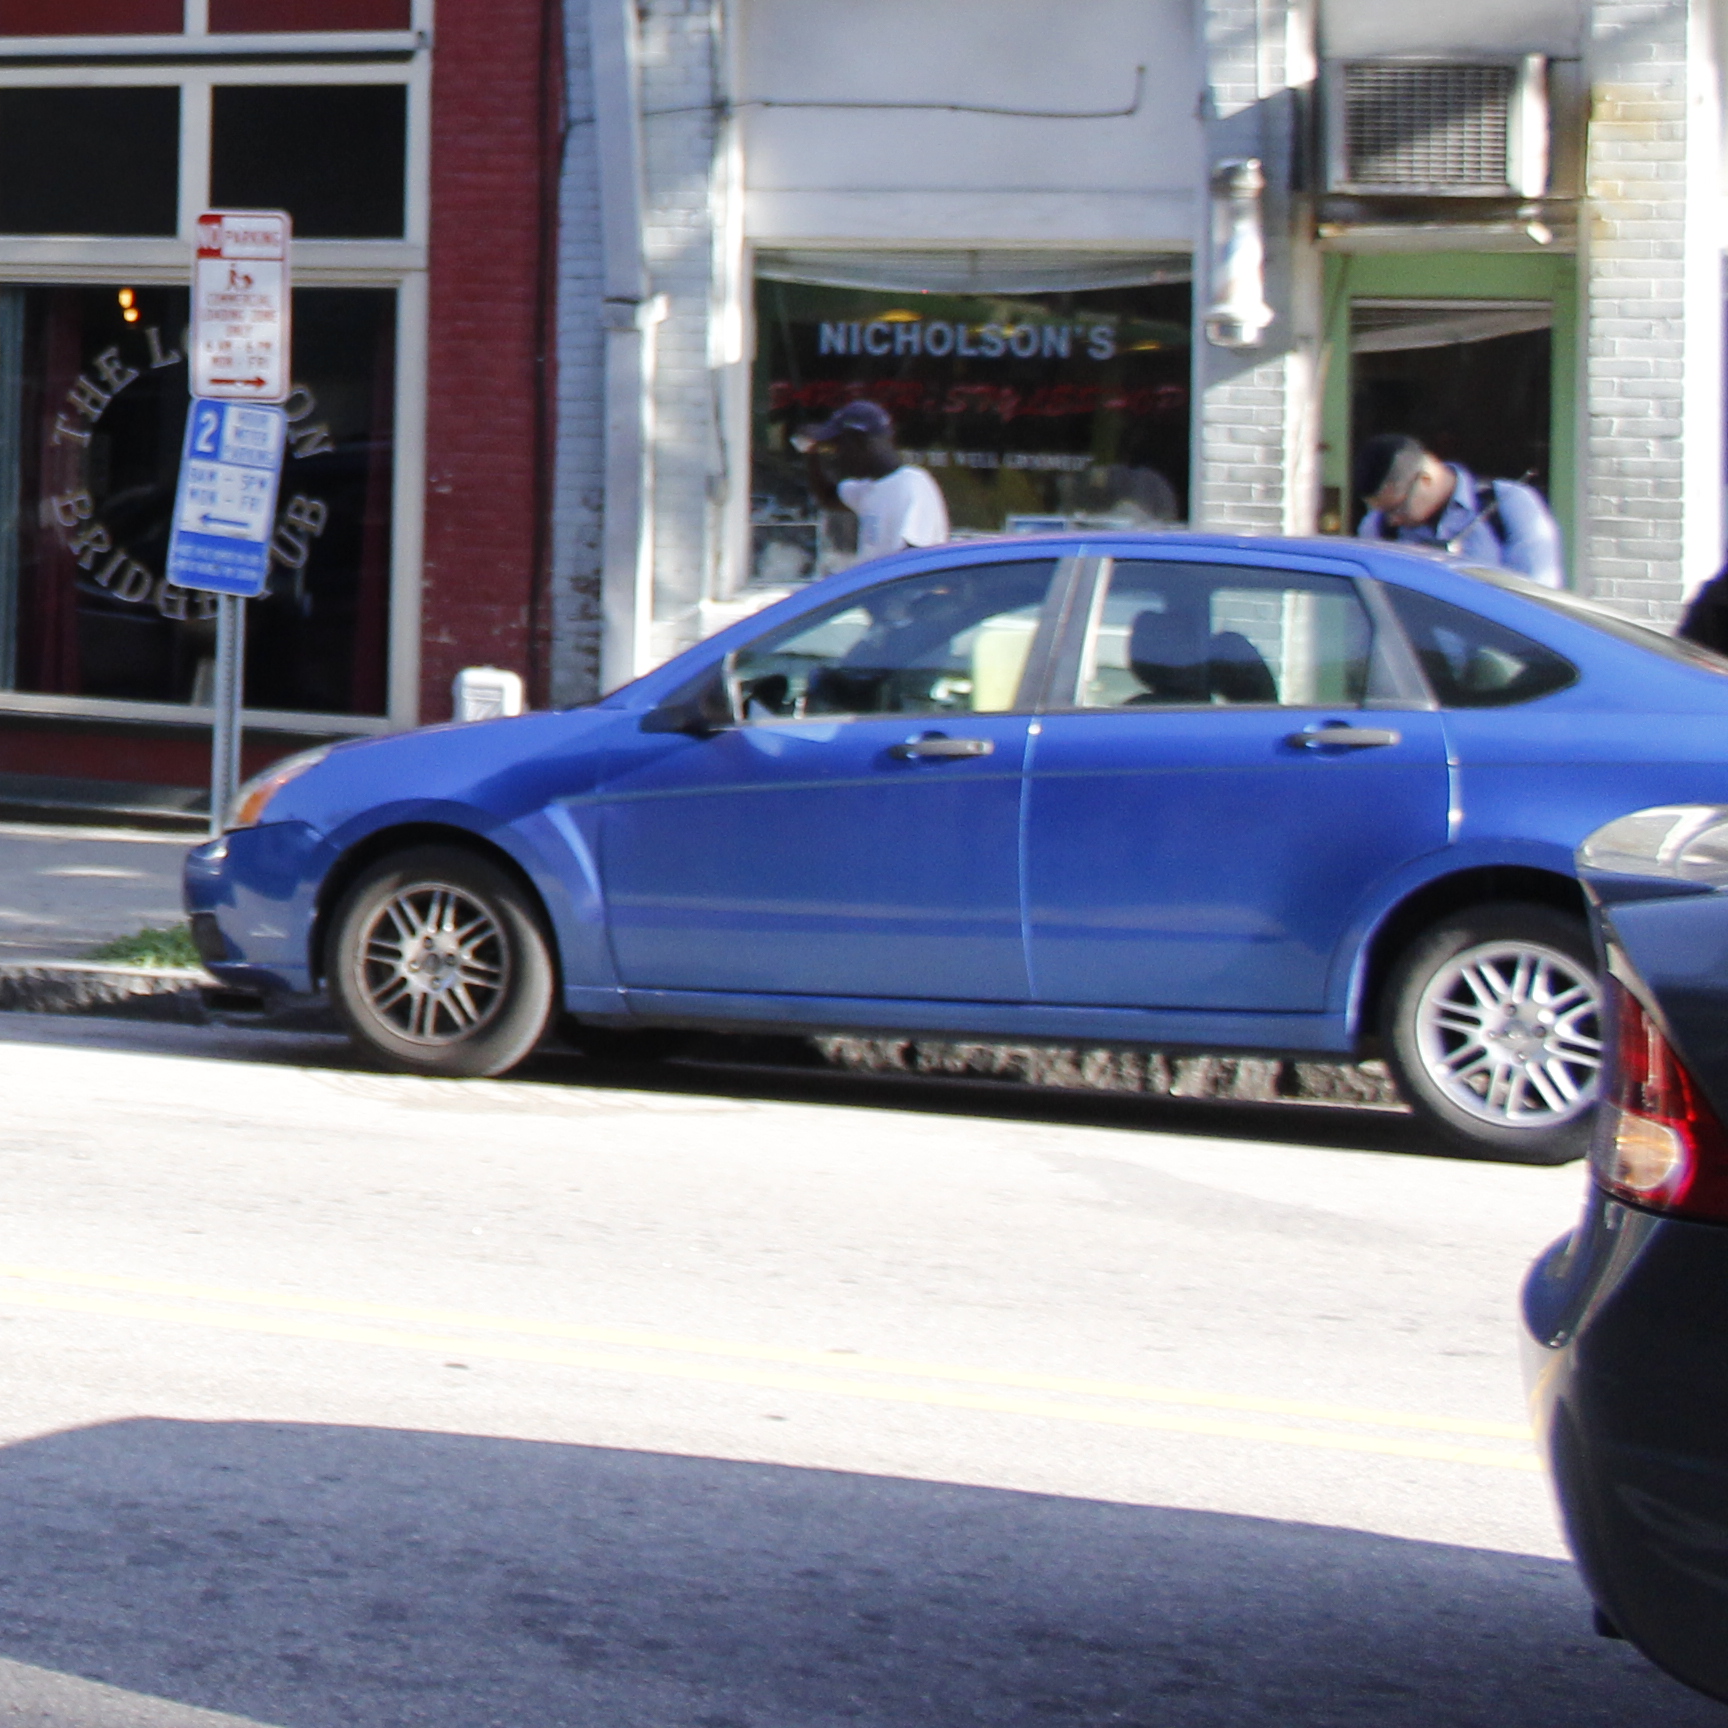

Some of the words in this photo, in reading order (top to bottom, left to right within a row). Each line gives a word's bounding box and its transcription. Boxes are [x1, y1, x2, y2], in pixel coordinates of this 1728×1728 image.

[818, 320, 1117, 362] NICHOLSON'S
[50, 346, 140, 448] THE
[195, 409, 218, 454] 2
